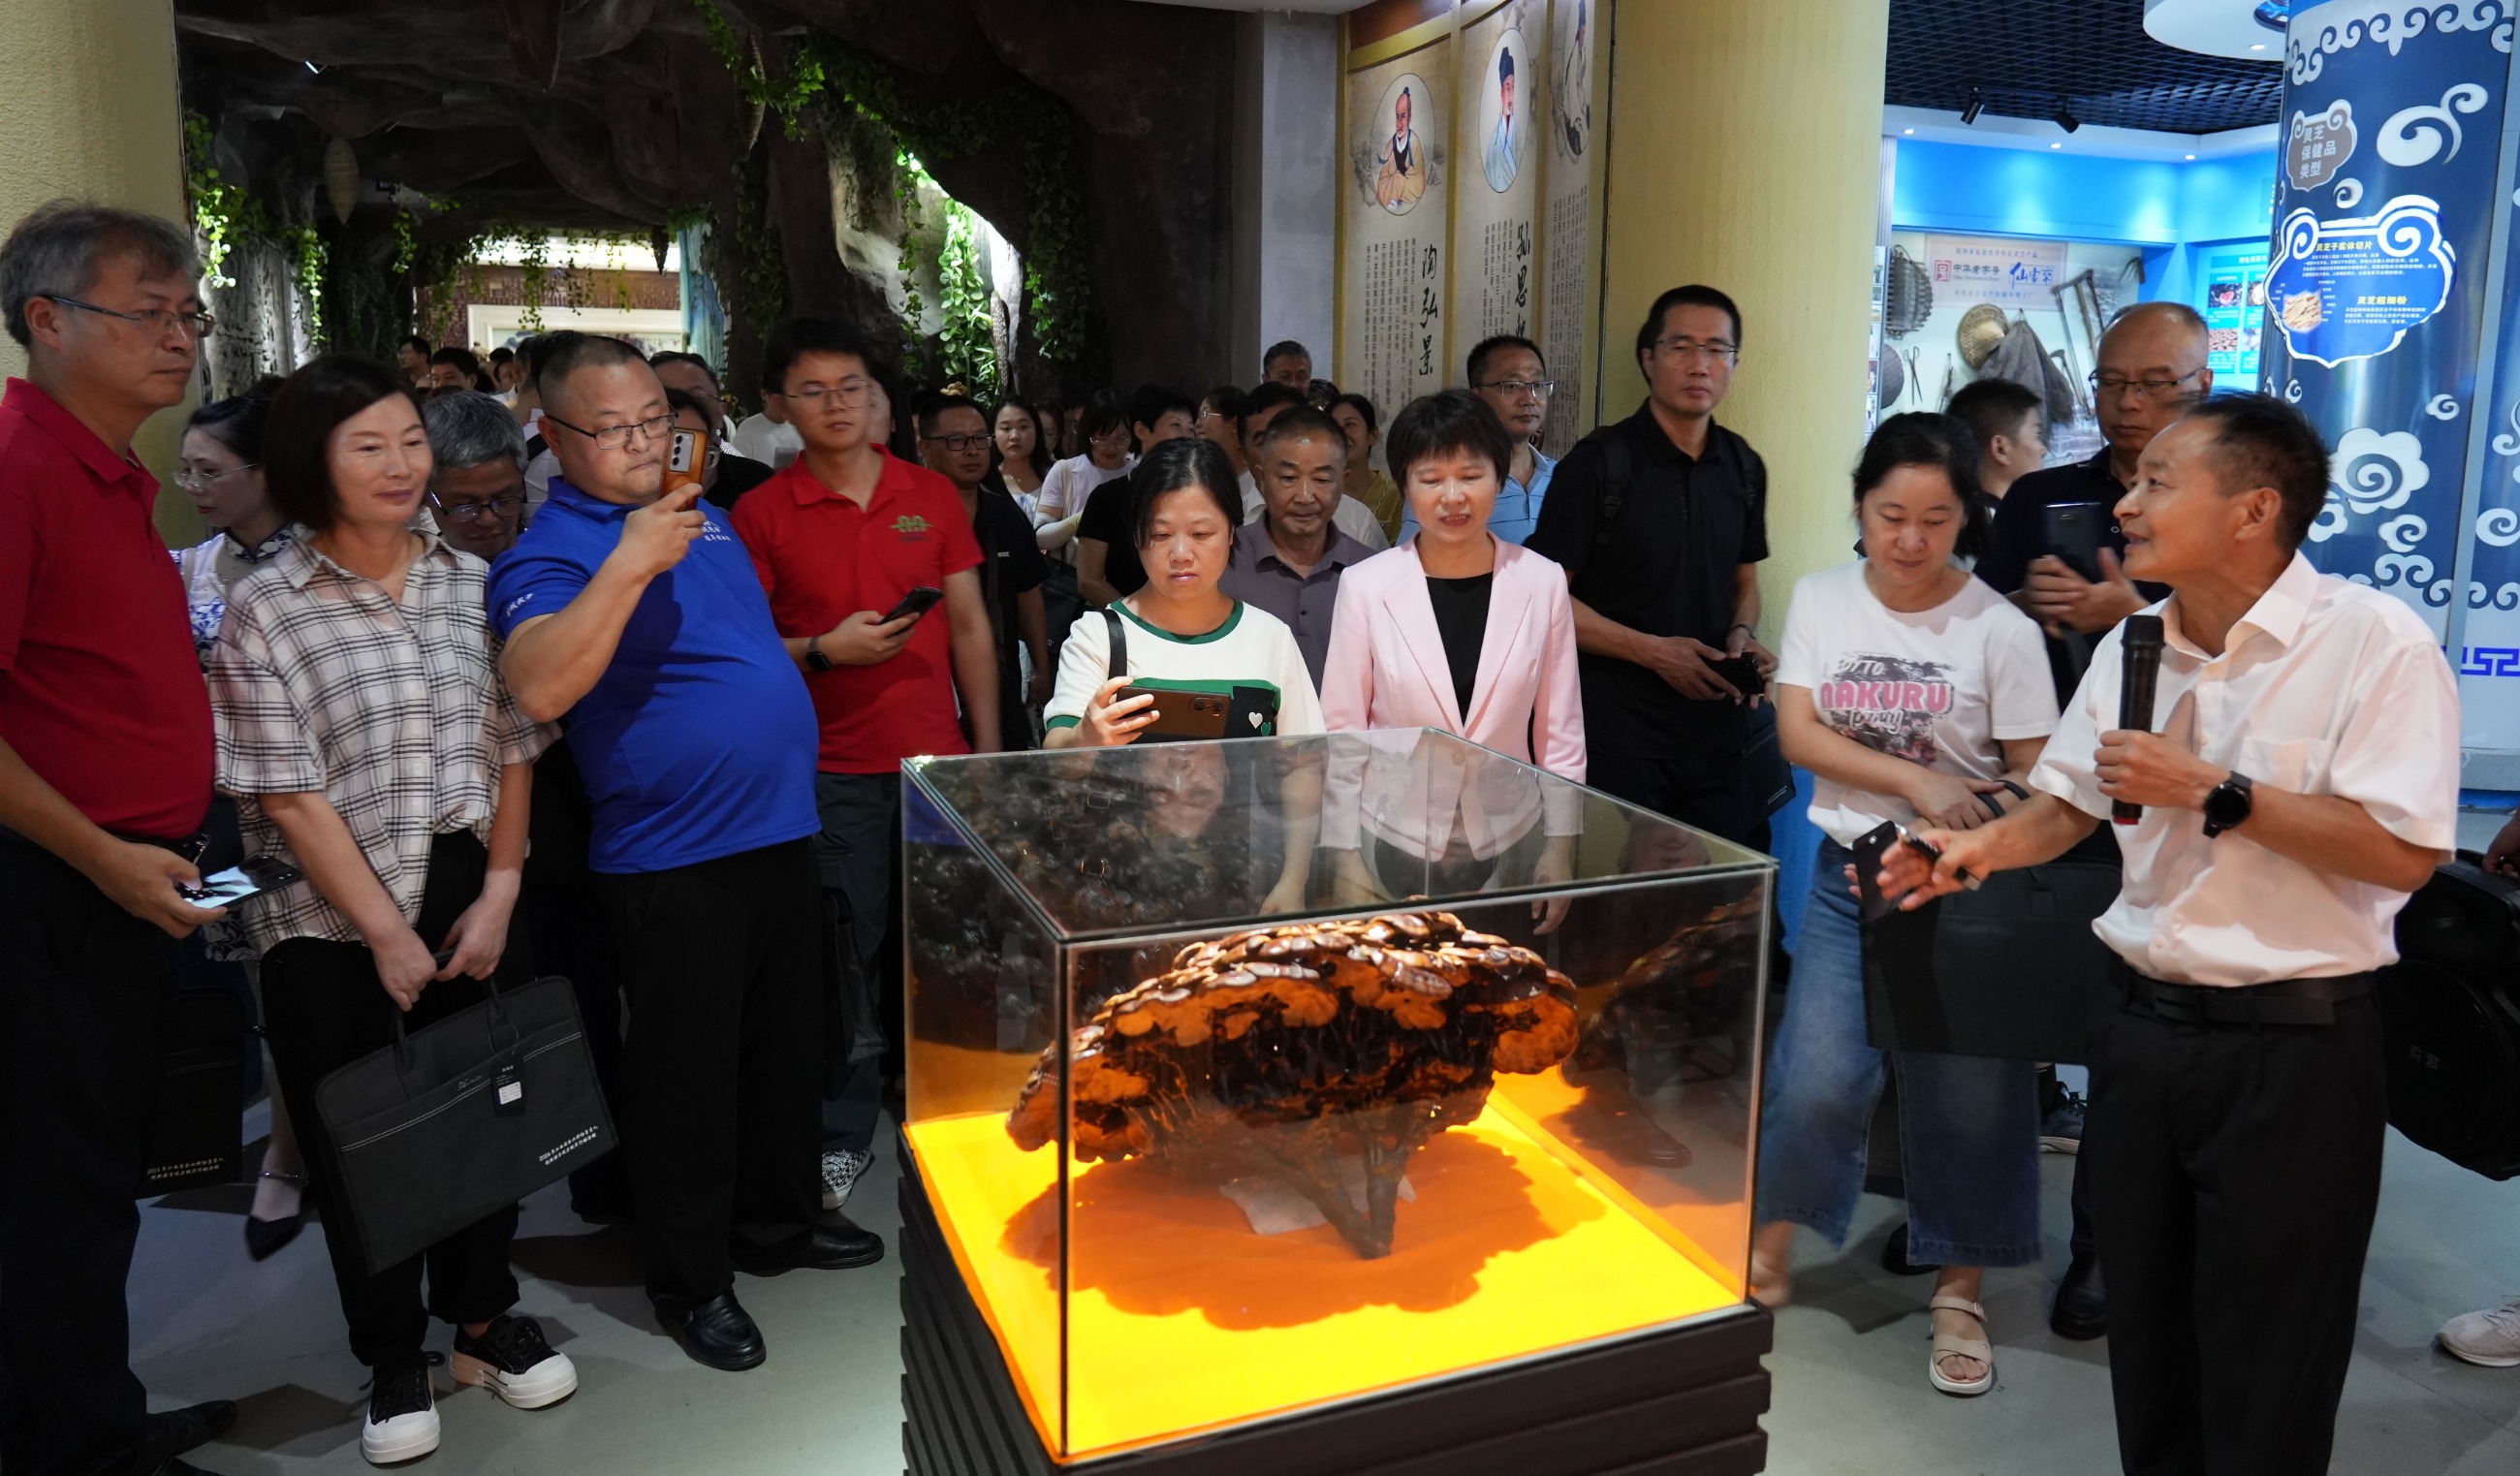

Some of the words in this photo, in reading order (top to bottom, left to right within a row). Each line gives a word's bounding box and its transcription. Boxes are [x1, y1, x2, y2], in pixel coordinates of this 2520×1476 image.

[2302, 123, 2325, 143] 灵芝
[2301, 140, 2337, 161] 保健品
[2300, 160, 2321, 179] 类型
